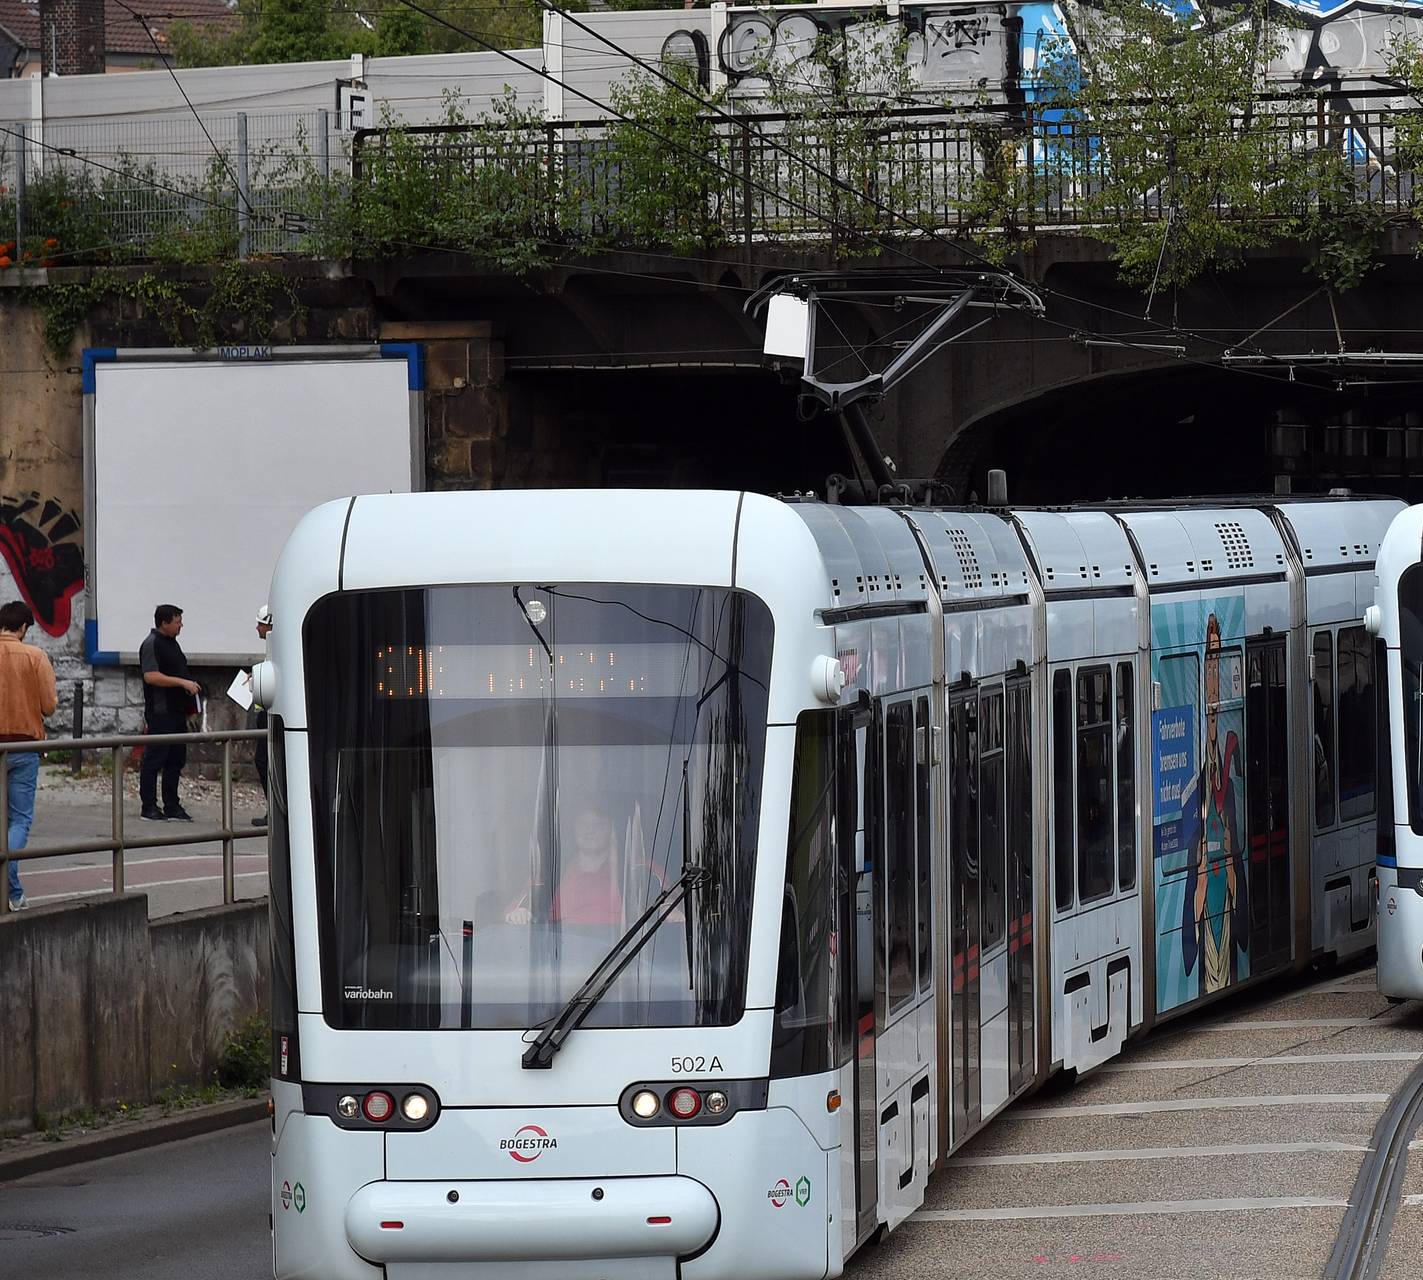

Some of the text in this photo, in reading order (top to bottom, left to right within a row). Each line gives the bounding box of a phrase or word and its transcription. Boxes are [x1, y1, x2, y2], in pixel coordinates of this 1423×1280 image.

[344, 988, 393, 999] variobahn
[671, 1055, 724, 1073] 502 A
[499, 1138, 558, 1150] BOGESTRA
[767, 1188, 794, 1199] BOGESTRA
